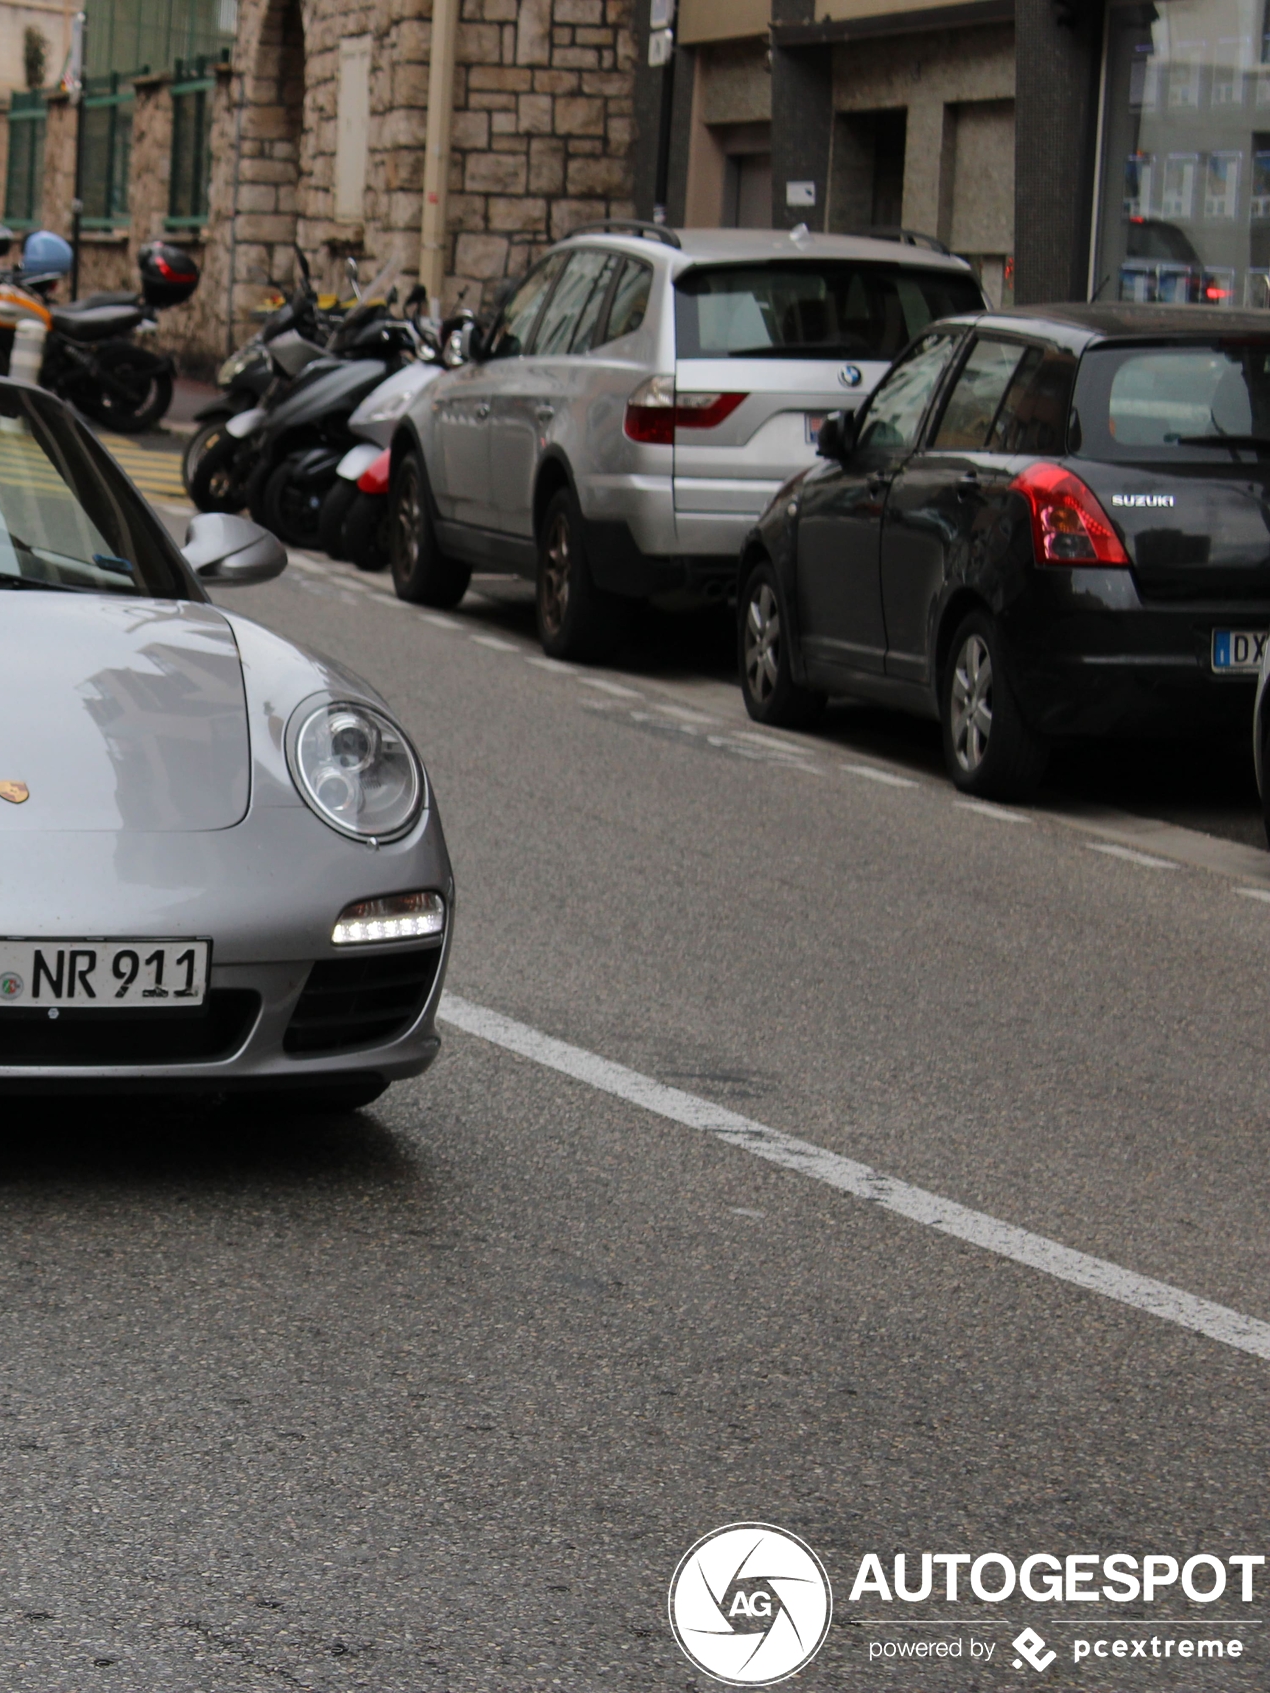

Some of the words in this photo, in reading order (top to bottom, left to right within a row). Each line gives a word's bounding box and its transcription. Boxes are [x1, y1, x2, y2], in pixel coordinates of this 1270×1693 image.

[1112, 494, 1174, 507] SUZUKI
[1234, 635, 1267, 663] DX
[31, 949, 97, 999] NR
[111, 949, 199, 998] 911
